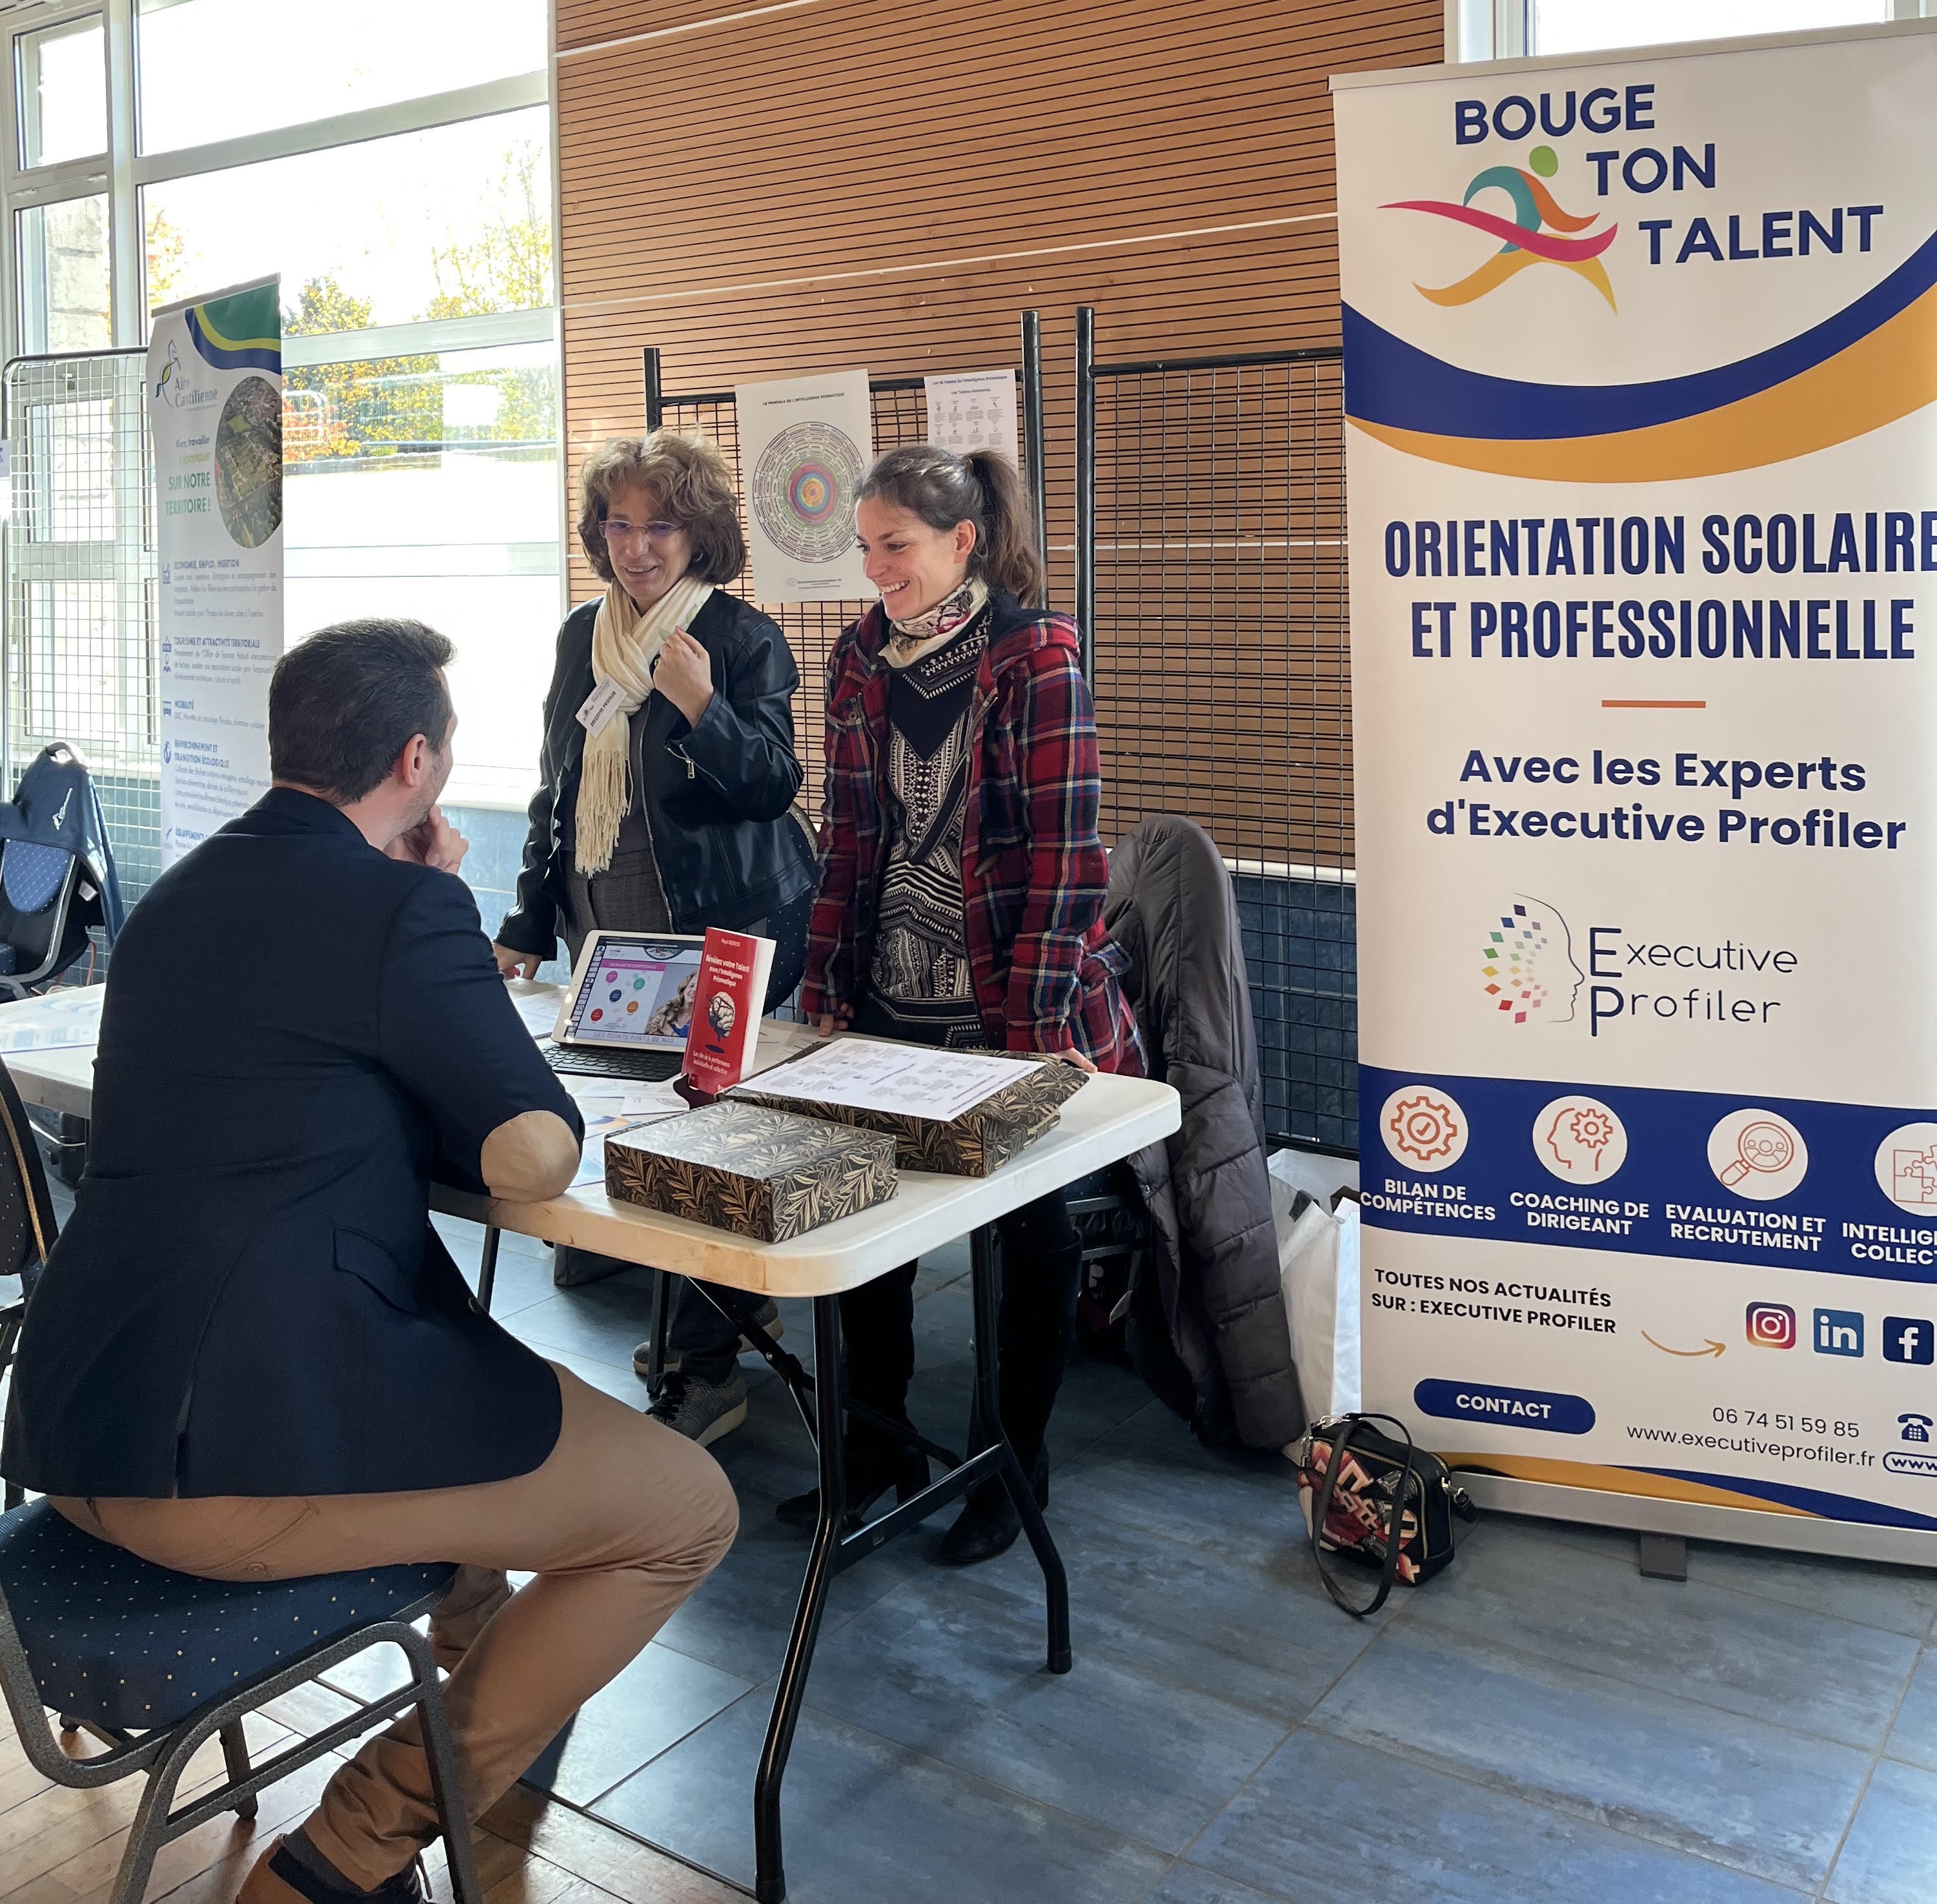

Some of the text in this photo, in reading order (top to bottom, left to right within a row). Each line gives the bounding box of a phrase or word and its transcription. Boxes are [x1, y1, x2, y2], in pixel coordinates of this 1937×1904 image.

[1455, 84, 1655, 145] BOUGE
[1586, 143, 1716, 196] TON
[1639, 205, 1883, 265] TALENT
[175, 376, 190, 390] Aire
[175, 388, 218, 407] Cantilienne
[168, 471, 210, 491] SUR NOTRE
[165, 498, 206, 516] TERRITOIRE
[1385, 511, 1937, 577] ORIENTATION SCOLAIRE
[174, 636, 196, 645] TOURISME
[197, 637, 201, 645] ET
[1411, 599, 1914, 659] ET PROFESSIONNELLE
[174, 699, 194, 709] MOBILITÉ
[174, 739, 218, 753] ENVIRONNEMENT ET
[174, 752, 229, 768] TRANSITION ÉCOLOGIQUE
[1459, 749, 1867, 800] Avec les Experts
[1426, 799, 1907, 850] d'Executive Profiler
[723, 960, 735, 969] votre
[1589, 927, 1798, 978] Executive
[1590, 986, 1781, 1037] Profiler
[1384, 1179, 1466, 1200] BILAN DE
[1359, 1190, 1496, 1221] COMPÉTENCES
[1510, 1191, 1650, 1219] COACHING DE
[1665, 1204, 1826, 1233] EVALUATION ET
[1526, 1212, 1633, 1236] DIRIGEANT
[1670, 1224, 1821, 1253] RECRUTEMENT
[1842, 1222, 1937, 1246] INTELLIG
[1851, 1242, 1937, 1266] COLLEC
[1375, 1268, 1612, 1308] TOUTES NOS ACTUALITÉS
[1372, 1293, 1407, 1312] SUR
[1419, 1300, 1523, 1324] EXECUTIVE
[1526, 1310, 1616, 1334] PROFILER
[1455, 1394, 1552, 1419] CONTACT
[1712, 1406, 1860, 1438] 06 74 51 59 85
[1626, 1424, 1876, 1467] www.executiveprofiler.fr
